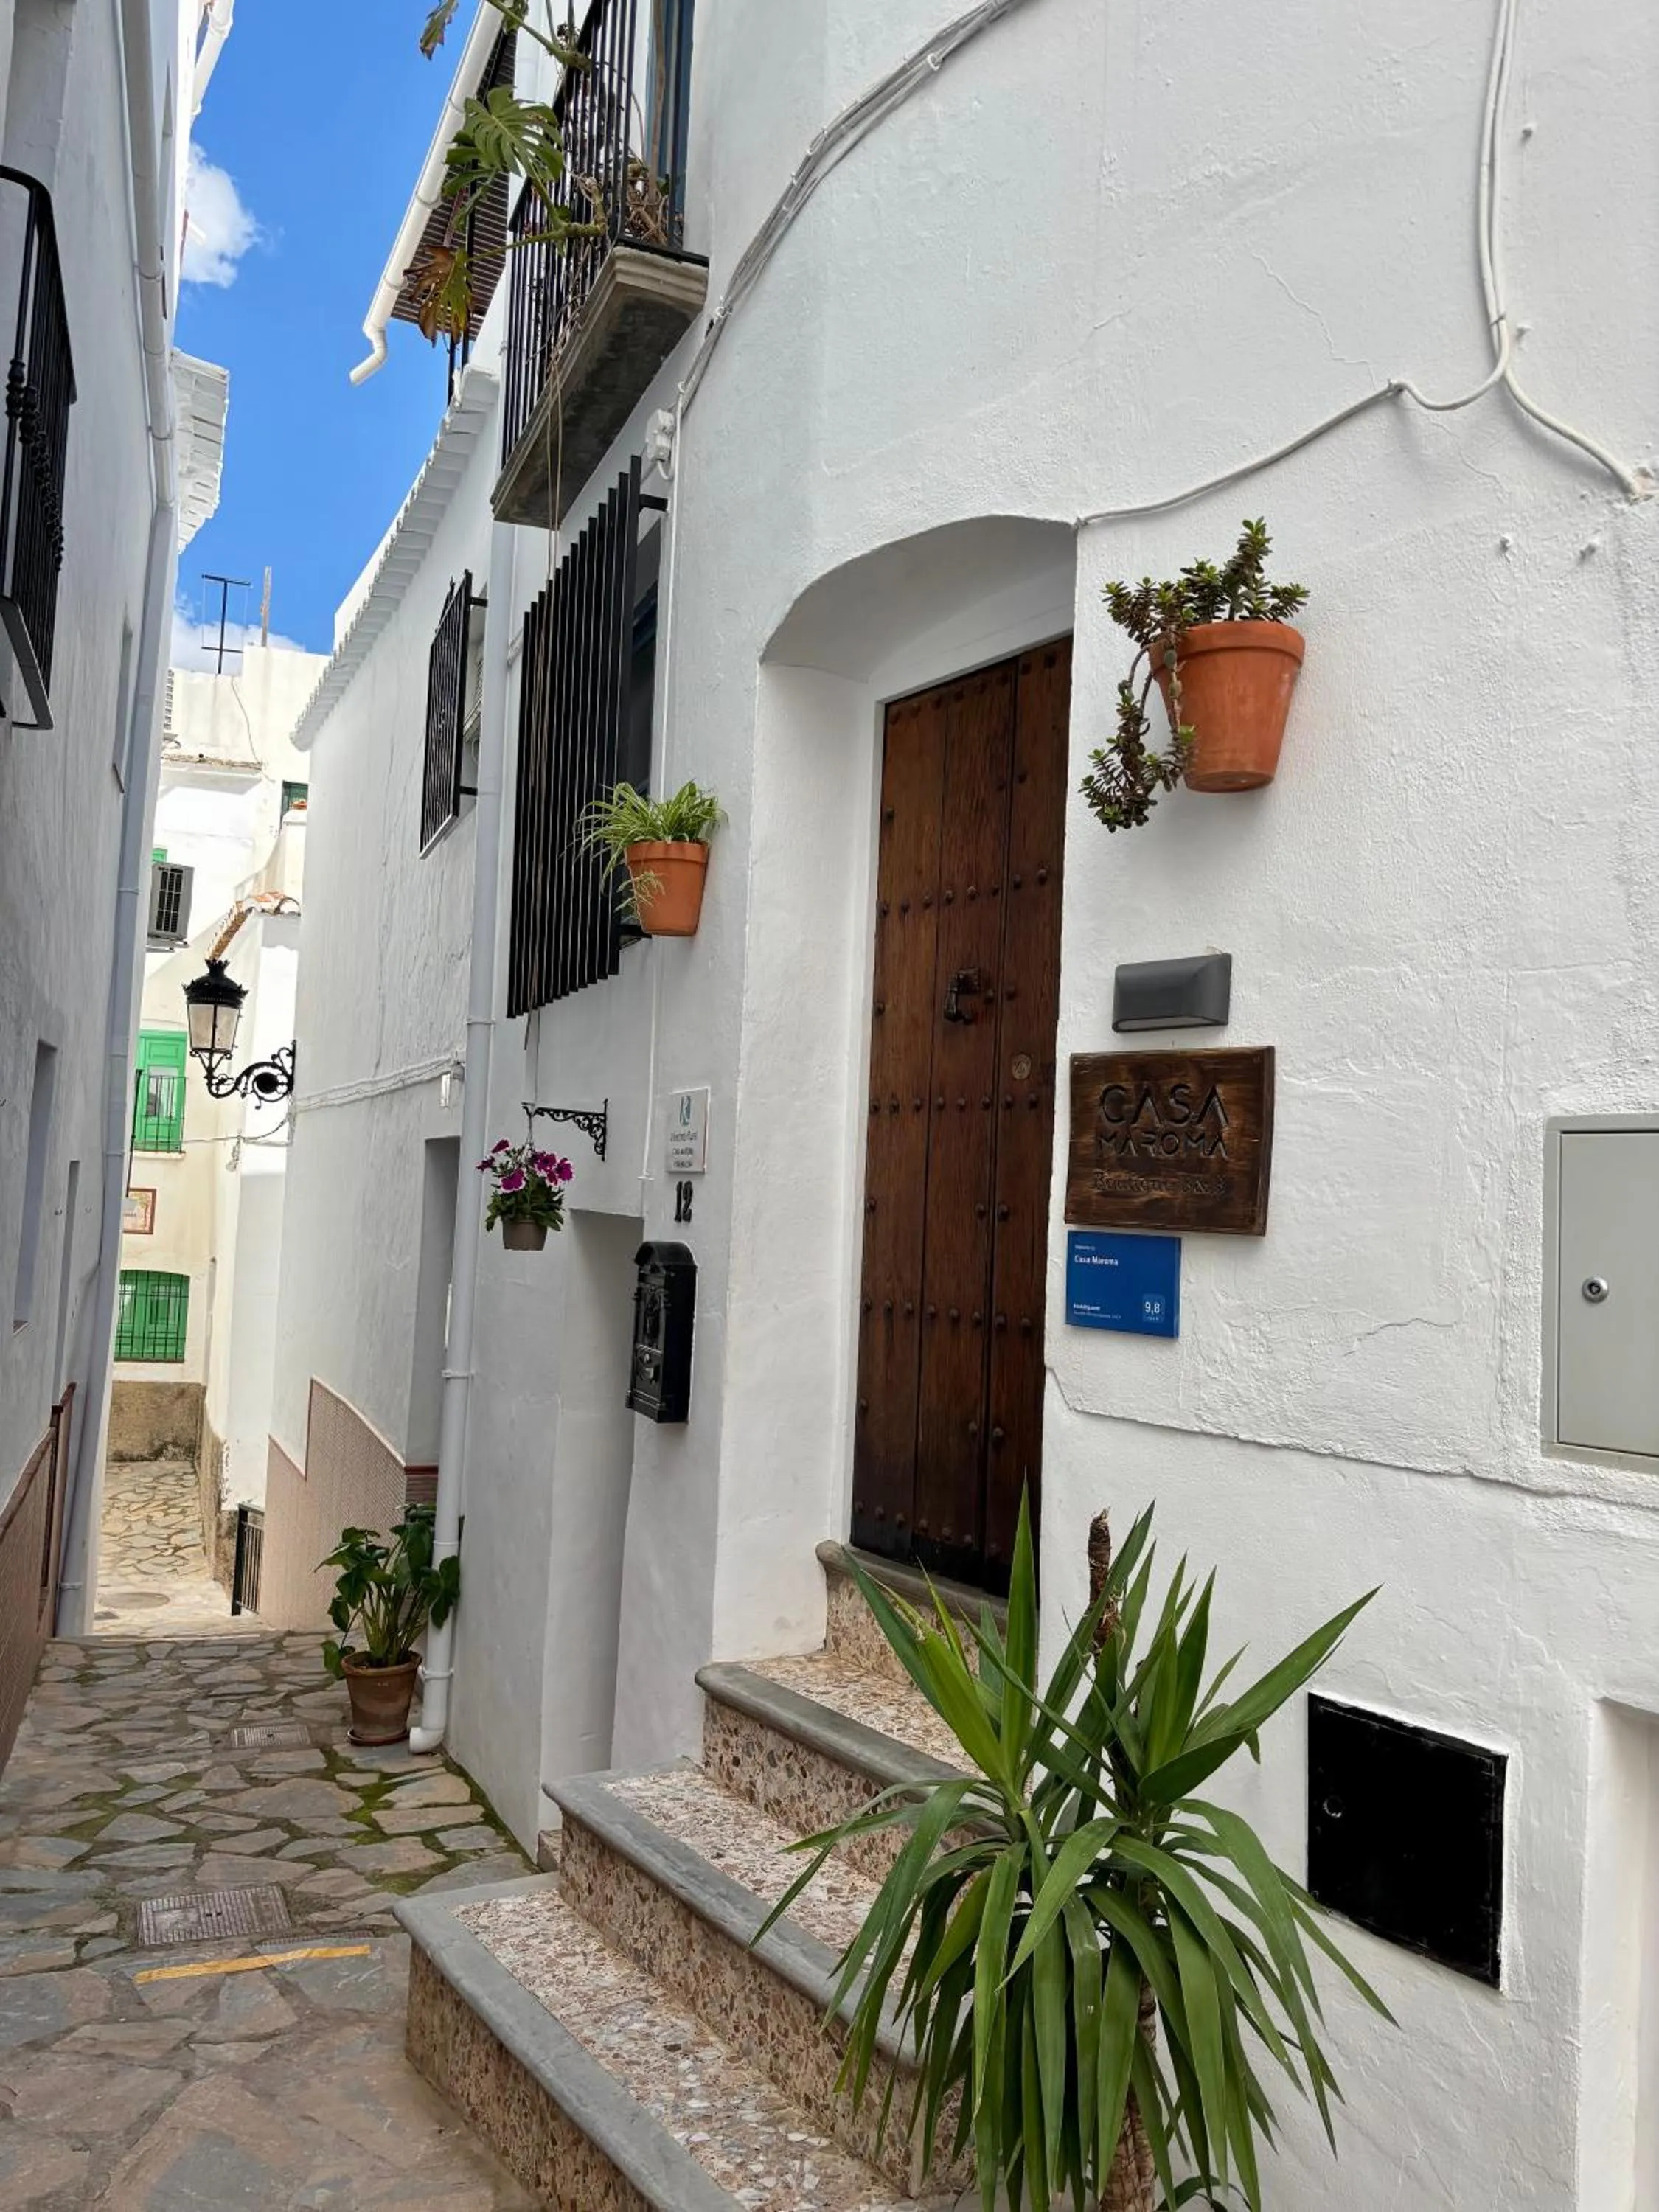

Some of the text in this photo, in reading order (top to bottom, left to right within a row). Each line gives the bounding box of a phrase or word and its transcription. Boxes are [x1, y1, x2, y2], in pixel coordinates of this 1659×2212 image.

[1099, 1082, 1229, 1130] CASA
[1097, 1130, 1230, 1160] MAROMA
[674, 1180, 693, 1224] 12
[1074, 1254, 1119, 1266] Casa Maroma
[1145, 1301, 1161, 1315] 9,8
